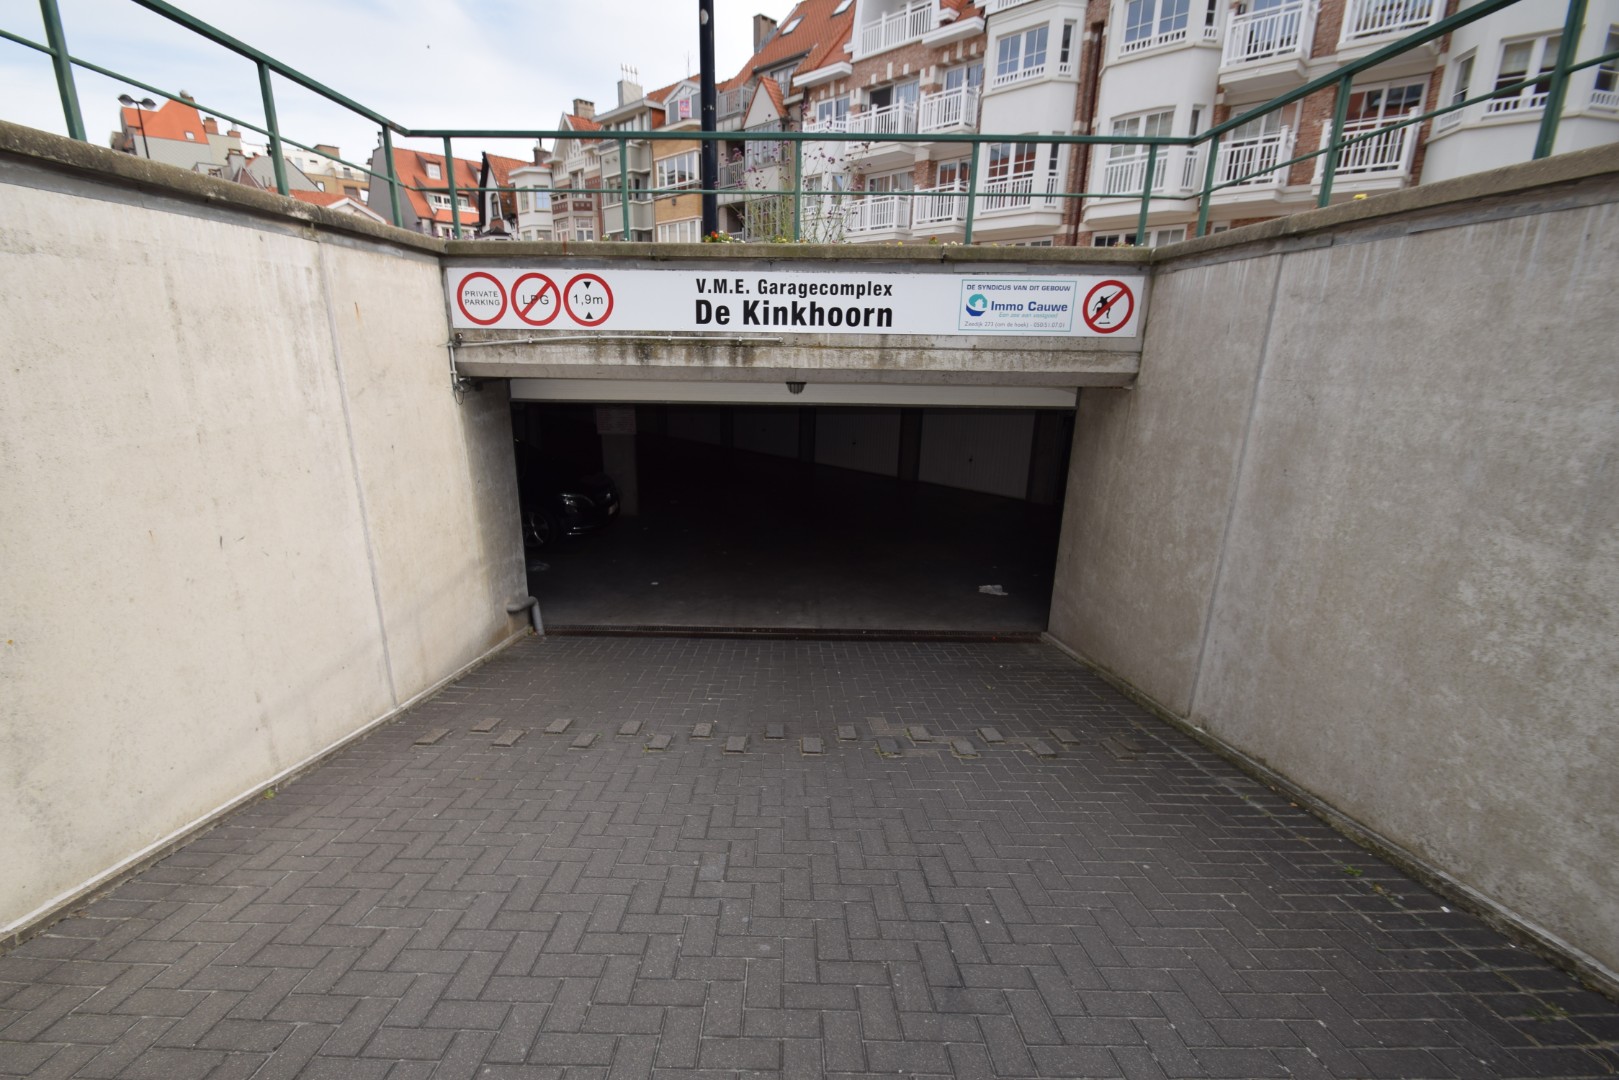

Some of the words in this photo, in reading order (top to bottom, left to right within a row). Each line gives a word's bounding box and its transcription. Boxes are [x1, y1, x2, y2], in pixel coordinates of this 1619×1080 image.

[464, 290, 499, 298] PRIVATE
[696, 278, 750, 294] V.M.E.
[758, 279, 893, 299] Garagecomplex
[464, 298, 501, 306] PARKING
[522, 294, 550, 305] LPG
[573, 294, 604, 306] 1,9m
[991, 301, 1024, 311] Immo
[1028, 301, 1068, 312] Cauwe
[695, 299, 731, 325] De
[743, 299, 893, 327] Kinkhoorn
